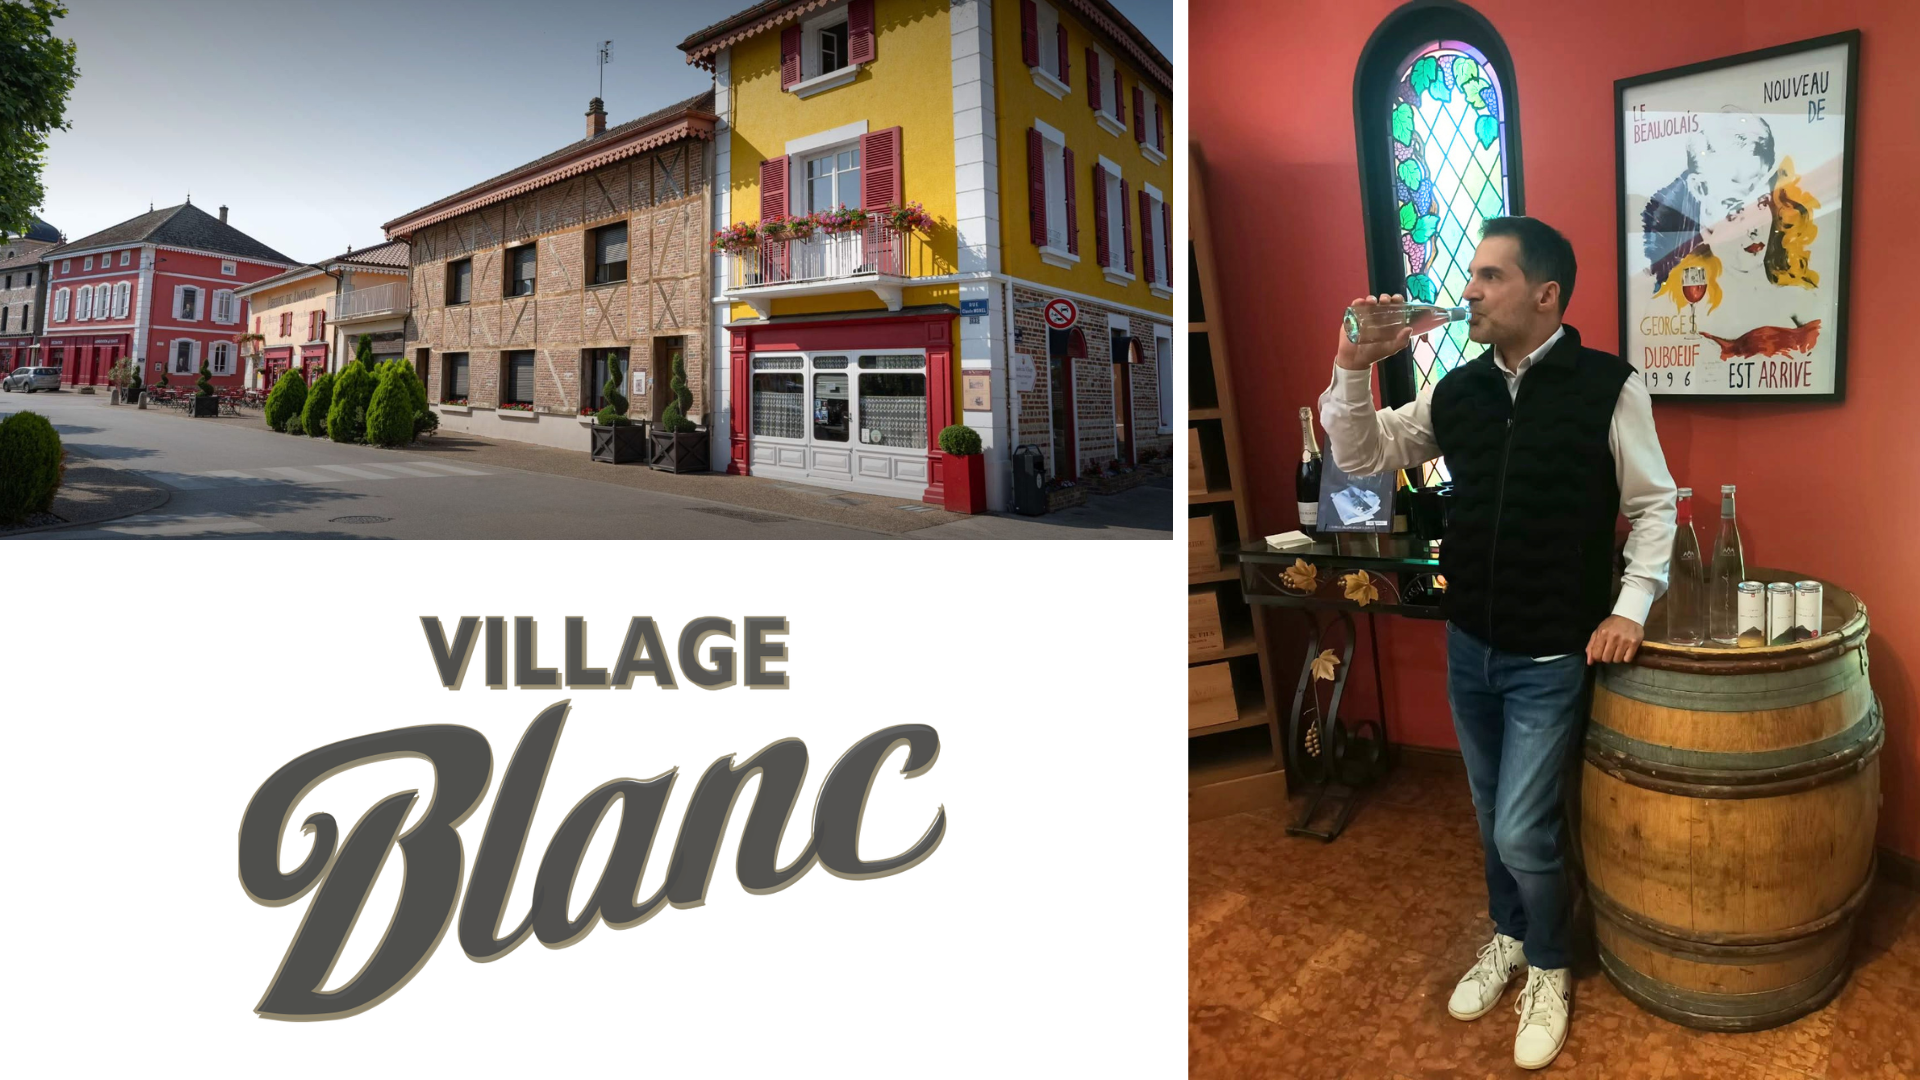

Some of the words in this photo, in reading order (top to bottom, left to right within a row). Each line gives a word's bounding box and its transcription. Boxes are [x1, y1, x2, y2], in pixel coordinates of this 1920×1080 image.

[1764, 71, 1829, 104] NOUVEAU
[1633, 104, 1646, 122] LE
[1808, 98, 1826, 123] DE
[1634, 110, 1699, 144] BEAUJOLAIS
[1640, 315, 1697, 336] GEORGES
[1644, 344, 1700, 369] DUBOEUF
[1729, 362, 1755, 388] EST
[1758, 352, 1812, 388] ARRIVÉ
